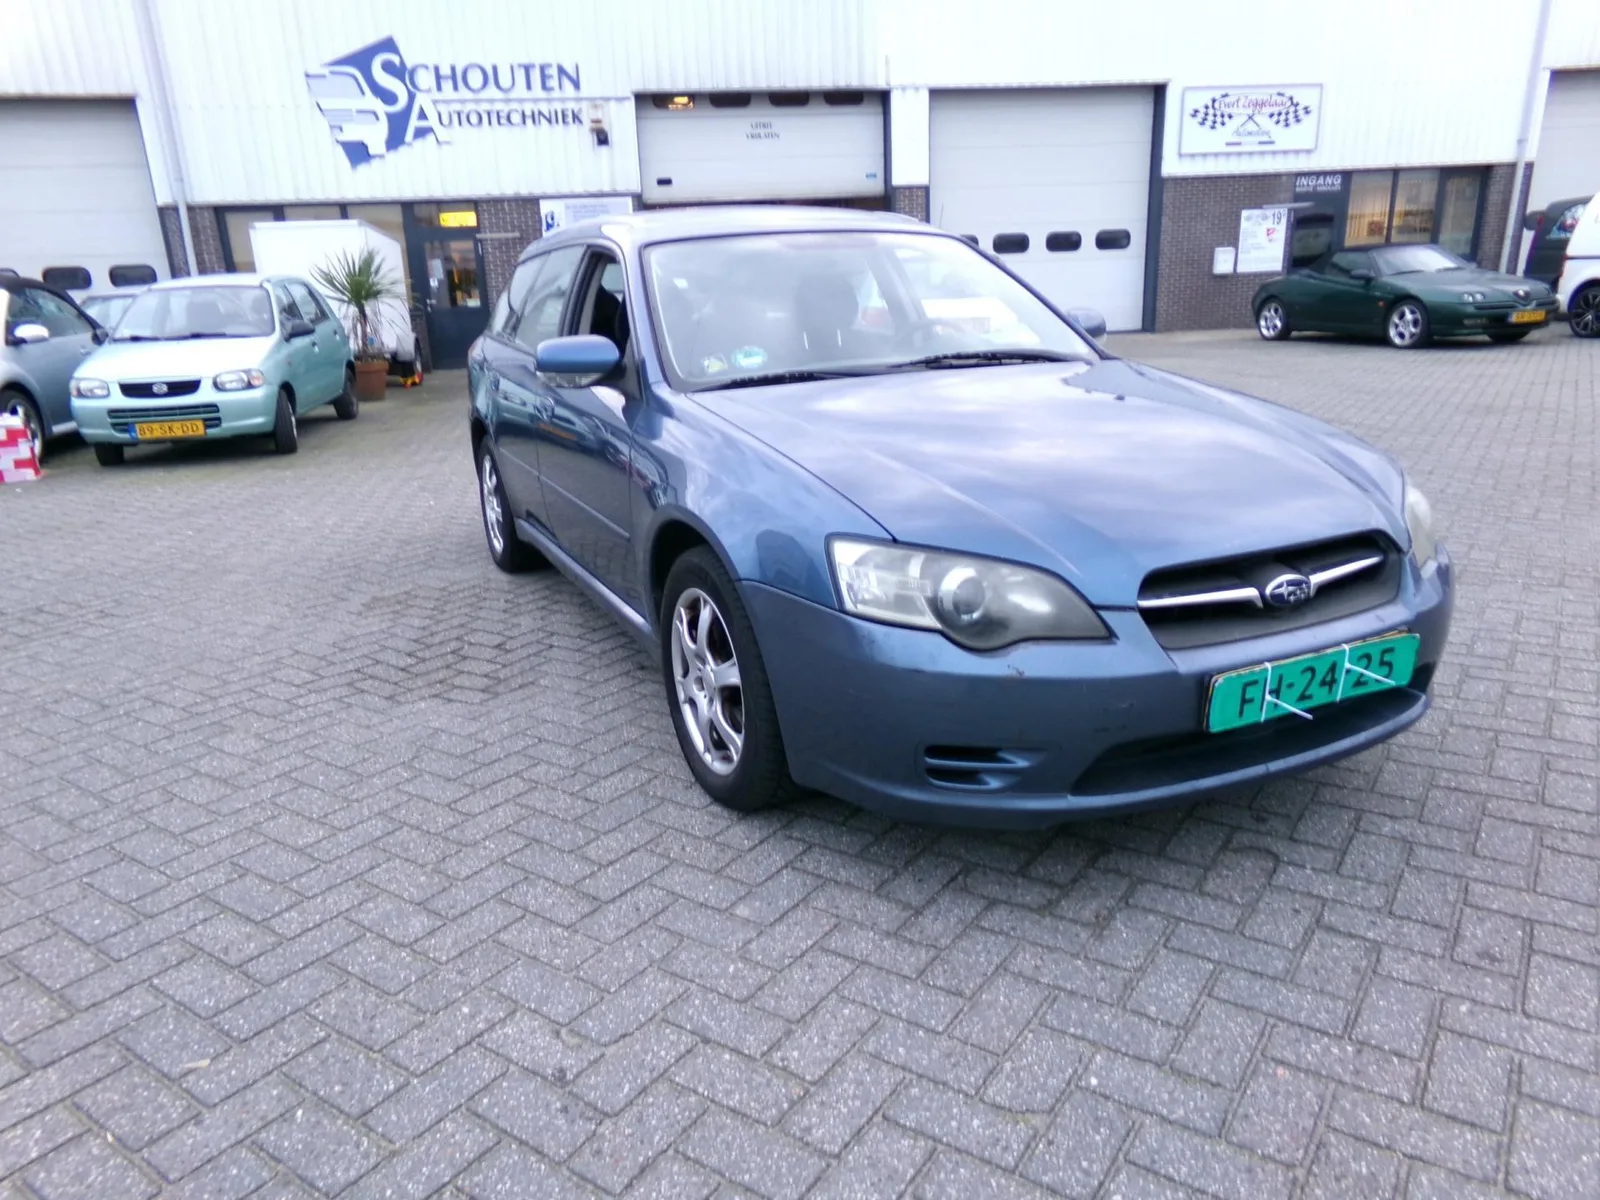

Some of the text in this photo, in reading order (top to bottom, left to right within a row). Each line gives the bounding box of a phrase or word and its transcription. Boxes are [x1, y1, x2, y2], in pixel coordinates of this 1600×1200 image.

[371, 51, 581, 114] SCHOUTEN
[404, 92, 584, 144] AUTOTECHNIEK
[1295, 174, 1342, 186] INGANG
[1238, 646, 1396, 718] FH-24-25
